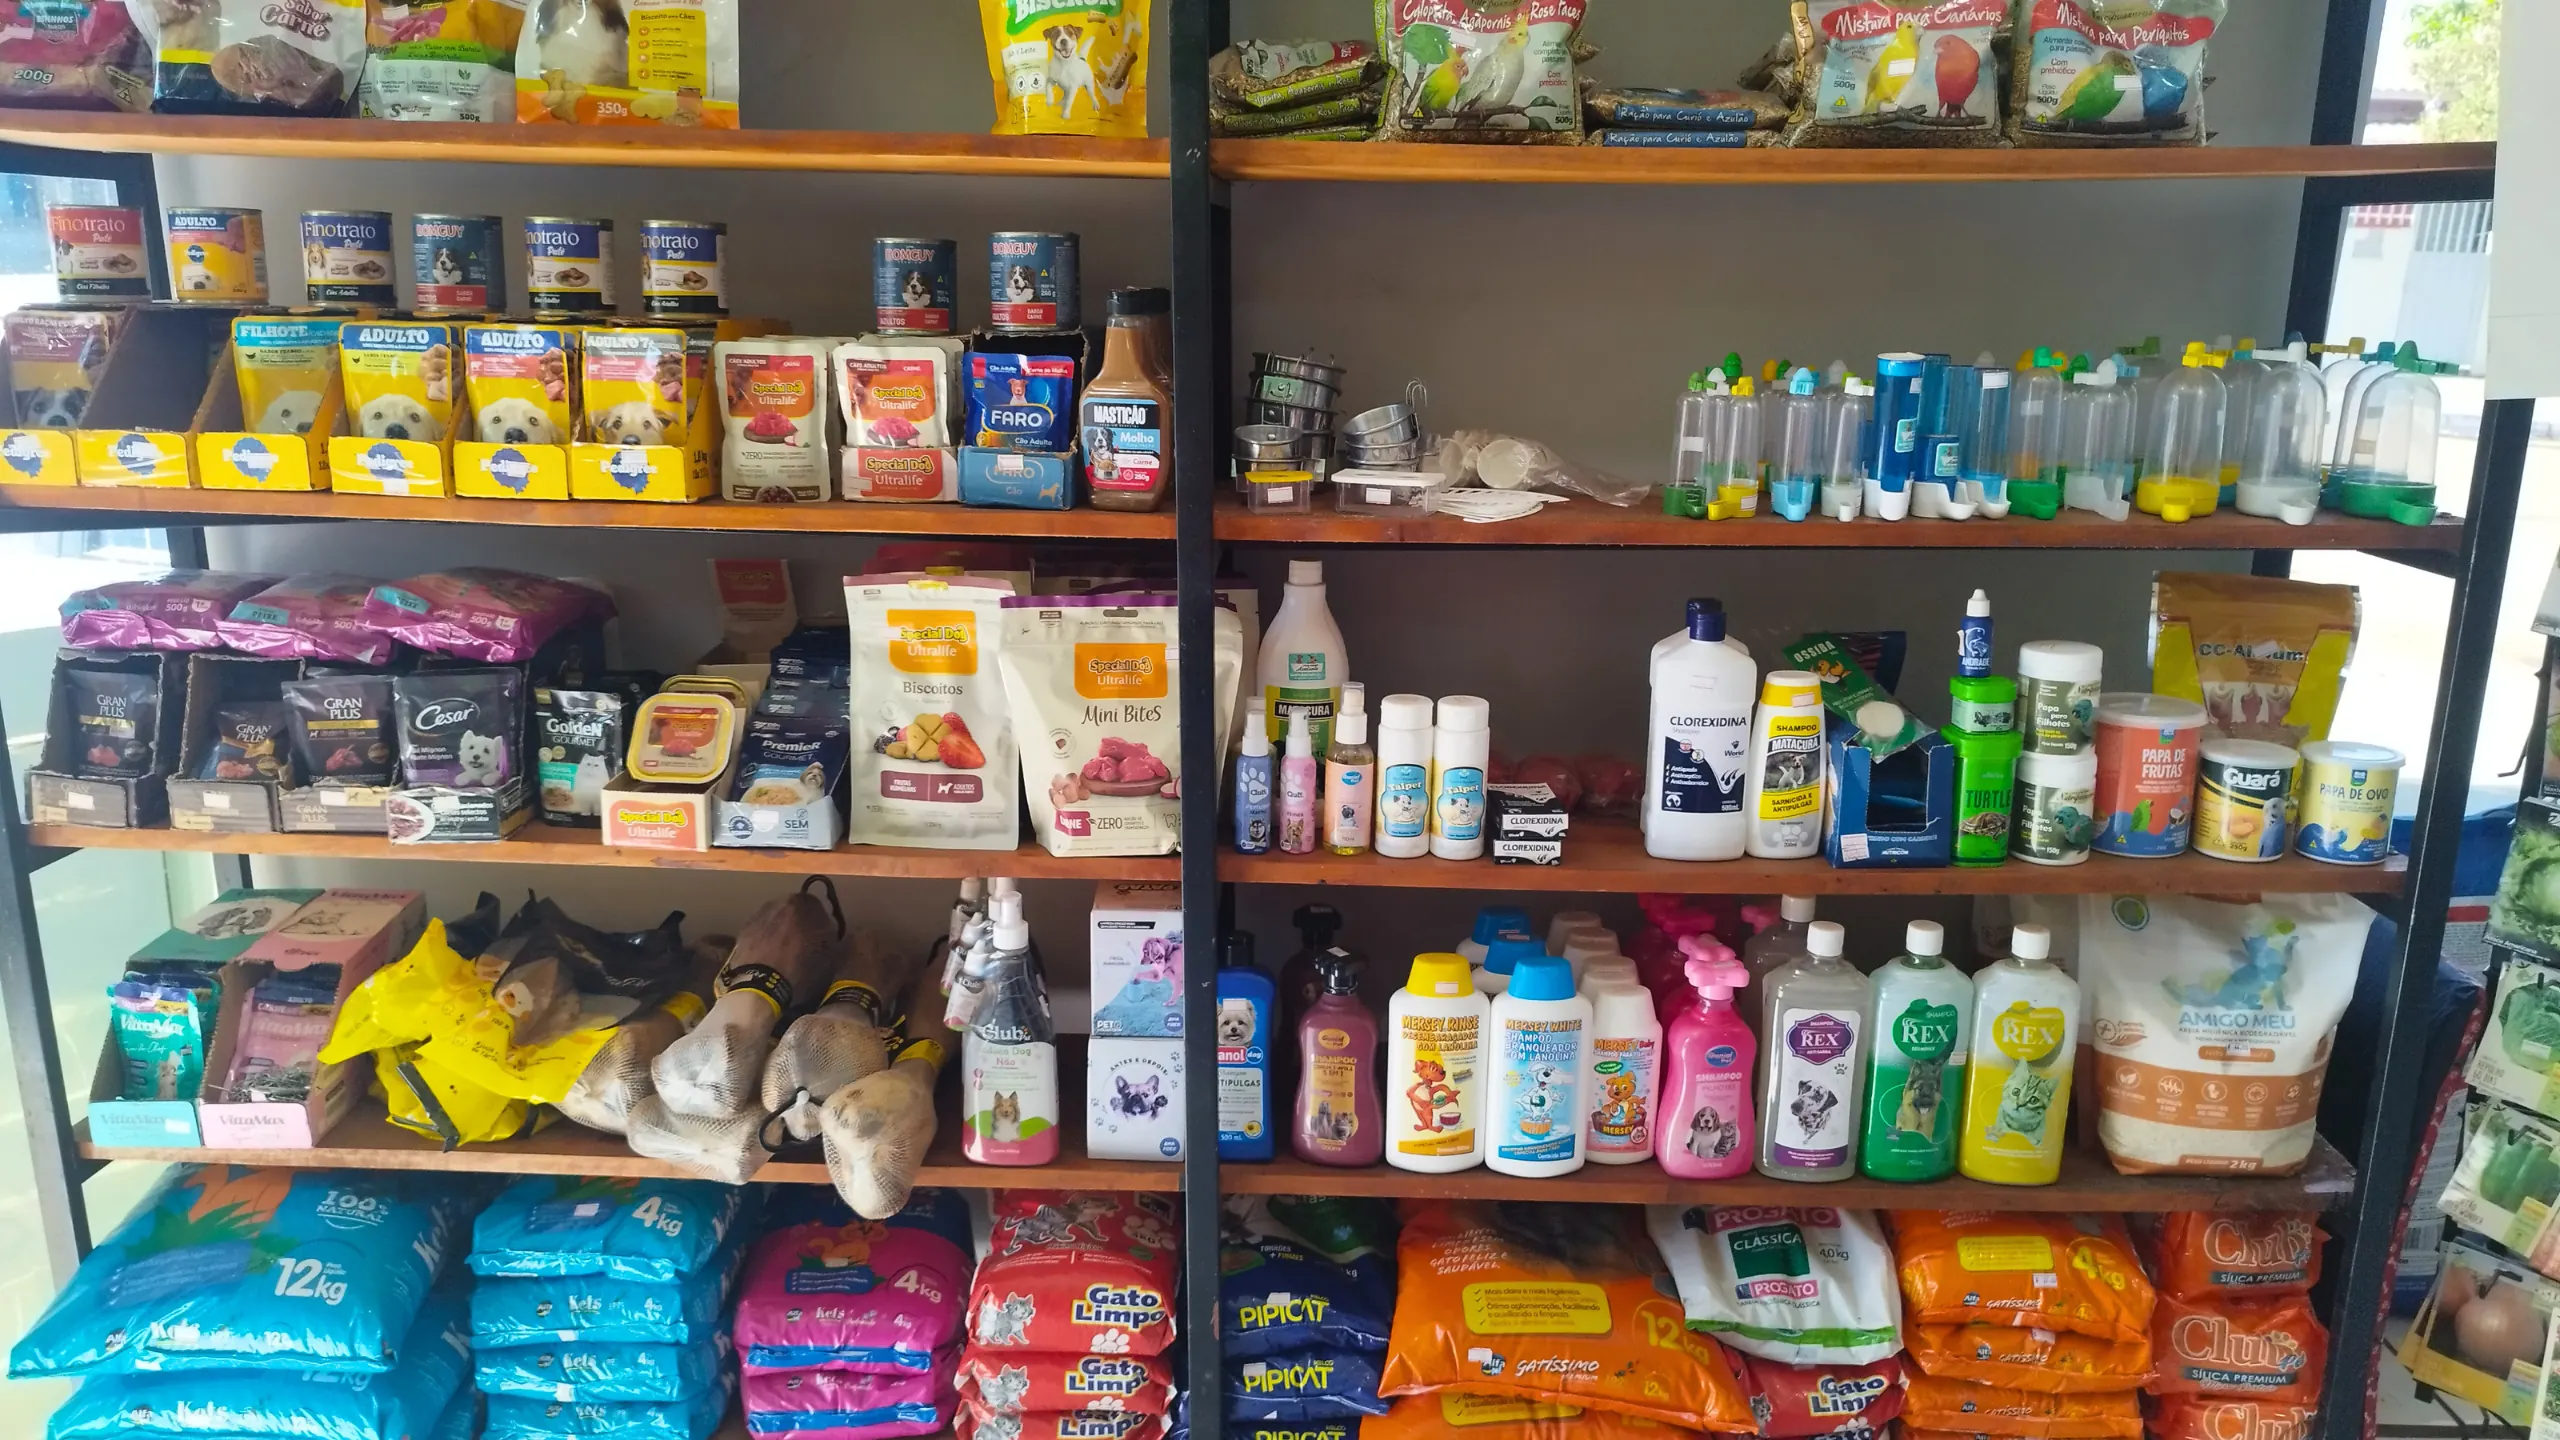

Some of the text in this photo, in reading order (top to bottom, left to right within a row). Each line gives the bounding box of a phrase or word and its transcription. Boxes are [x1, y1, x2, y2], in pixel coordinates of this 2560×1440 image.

[1836, 9, 1891, 38] Mistura
[1934, 4, 2003, 27] Canários
[2098, 28, 2127, 47] para
[2131, 24, 2190, 44] Periquitos
[14, 68, 54, 84] 200g
[1833, 80, 1856, 91] 500g
[2036, 95, 2059, 106] 500g
[597, 102, 628, 118] 350g
[1620, 106, 1650, 124] Ração
[1652, 109, 1671, 124] para
[1672, 110, 1703, 125] Curió
[1716, 110, 1750, 126] Azulão
[1555, 116, 1573, 126] 500g
[1609, 130, 1634, 147] Ração
[1636, 134, 1662, 147] para
[1665, 132, 1692, 146] Curió
[1706, 132, 1741, 146] Azulão
[51, 215, 126, 233] Finotrato
[174, 215, 217, 227] ADULTO
[304, 222, 376, 239] Finotrato
[885, 247, 936, 261] BOMGUY
[992, 242, 1038, 256] BOMGUY
[240, 325, 309, 338] FILHOTE
[359, 328, 429, 344] ADULTO
[481, 332, 545, 349] ADULTO
[752, 379, 804, 396] Special Dog
[872, 384, 925, 401] Special Dog
[759, 394, 797, 406] Ultralife
[879, 400, 918, 411] Ultralife
[991, 410, 1043, 428] FARO
[1093, 404, 1147, 425] MASTICÃO
[1015, 436, 1053, 446] Cão Adulto
[1120, 431, 1154, 443] Molho
[745, 451, 764, 461] ZERO
[1133, 458, 1153, 466] Carne
[600, 459, 660, 477] Pedigree
[866, 455, 935, 475] Special Dog
[875, 474, 923, 487] Ultralife
[165, 602, 188, 613] 500g
[470, 615, 492, 627] 500g
[944, 625, 969, 644] Dog
[908, 643, 957, 658] Ultralife
[1089, 656, 1153, 675] Special Dog
[1962, 656, 1990, 668] ANDRADE
[1097, 674, 1143, 686] Ultralife
[903, 680, 964, 696] Biscoitos
[96, 694, 127, 707] GRAN
[324, 697, 363, 710] GRAN
[99, 706, 125, 718] PLUS
[330, 708, 362, 720] PLUS
[1081, 704, 1119, 726] Mini
[2037, 702, 2060, 714] Papa
[414, 704, 475, 731] Cesar
[1669, 716, 1747, 727] CLOREXIDINA
[2037, 717, 2071, 729] Filhotes
[2050, 712, 2068, 722] para
[236, 722, 272, 735] GRAN
[1775, 724, 1818, 733] SHAMPOO
[552, 735, 598, 748] GOURMET
[1772, 737, 1820, 752] MATACURA
[763, 751, 813, 762] GOURMET
[1724, 749, 1744, 757] World
[2142, 748, 2187, 763] PAPA DE
[2142, 764, 2183, 779] FRUTAS
[2222, 767, 2281, 790] Guará
[953, 782, 975, 791] ADULTOS
[2319, 783, 2389, 801] PAPA DE OVO
[1771, 793, 1808, 806] SARNICIDA
[1772, 800, 1813, 812] ANTIPULGAS
[1965, 789, 2011, 809] TURTLE
[296, 805, 328, 815] GRAN
[618, 807, 687, 826] Special Dog
[784, 819, 810, 830] SEM
[1096, 817, 1123, 830] ZERO
[1510, 816, 1564, 826] CLOREXIDINA
[627, 825, 677, 839] Ultralife
[1502, 843, 1556, 853] CLOREXIDINA
[1926, 1010, 1956, 1019] SHAMPOO
[2178, 1010, 2297, 1030] AMIGO MEU
[1401, 1013, 1480, 1032] MERSEY RINSE
[1504, 1018, 1583, 1033] MERSEY WHITE
[1504, 1031, 1552, 1044] SHAMPOO
[1901, 1018, 1951, 1044] REX
[2002, 1018, 2057, 1046] REX
[1801, 1029, 1841, 1048] REX
[1416, 1040, 1479, 1053] COM LANOLINA
[1504, 1041, 1578, 1053] BRANQUEADOR
[996, 1056, 1016, 1066] Não
[1217, 1048, 1263, 1063] anol dog
[1504, 1050, 1577, 1063] COM LANOLINA
[1695, 1071, 1743, 1083] SHAMPOO
[219, 1113, 286, 1126] VittaMax
[1602, 1125, 1634, 1136] MERSEY
[316, 1203, 384, 1224] NATURAL
[1733, 1232, 1803, 1251] CLÁSSICA
[2203, 1218, 2304, 1268] Club
[1430, 1255, 1460, 1268] GATO
[1461, 1252, 1499, 1264] FELIZ
[2219, 1270, 2302, 1284] SÍLICA PREMIUM
[1753, 1280, 1815, 1299] PROGATO
[568, 1295, 602, 1313] Kets
[1089, 1286, 1159, 1308] Gato
[1986, 1298, 2043, 1311] GATÍSSIMO
[816, 1306, 845, 1319] Kets
[1075, 1304, 1166, 1330] Limpo
[1239, 1297, 1330, 1329] PIPICAT
[2172, 1314, 2294, 1369] Club
[1516, 1356, 1601, 1374] GATÍSSIMO
[1999, 1351, 2050, 1366] GATÍSSIMO
[1082, 1357, 1148, 1376] Gato
[1243, 1365, 1335, 1394] PIPICAT
[1561, 1373, 1600, 1382] PREMIUM
[2191, 1367, 2287, 1386] SÍLICA PREMIUM
[1820, 1377, 1885, 1396] Gato
[1061, 1414, 1145, 1439] Limpo
